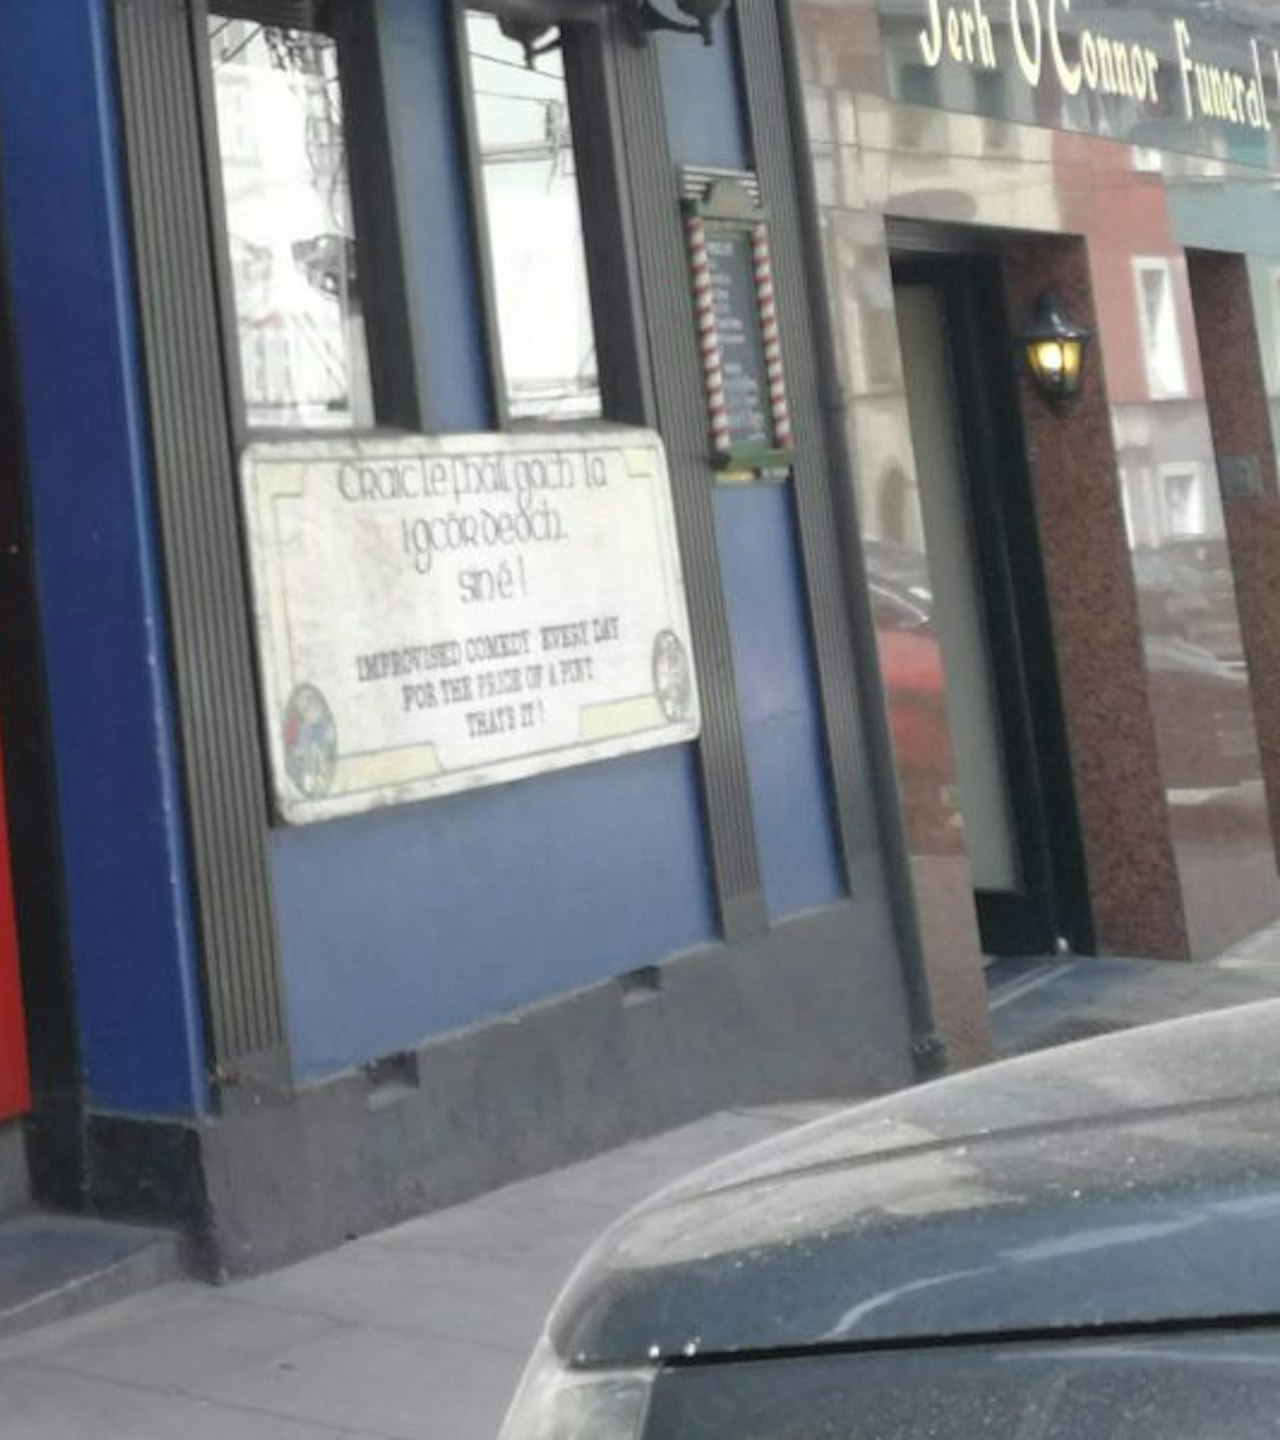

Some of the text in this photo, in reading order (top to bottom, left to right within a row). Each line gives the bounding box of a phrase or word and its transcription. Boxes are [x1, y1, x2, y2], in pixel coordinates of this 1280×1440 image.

[1174, 17, 1272, 132] Funeral
[355, 616, 620, 682] IMPROVISED COMEDY EVERY DAY
[401, 681, 438, 712] FOR
[440, 674, 474, 705] THE
[477, 667, 523, 698] PRICE
[525, 663, 544, 689] OF
[547, 660, 559, 687] A
[465, 706, 516, 738] THAT'S
